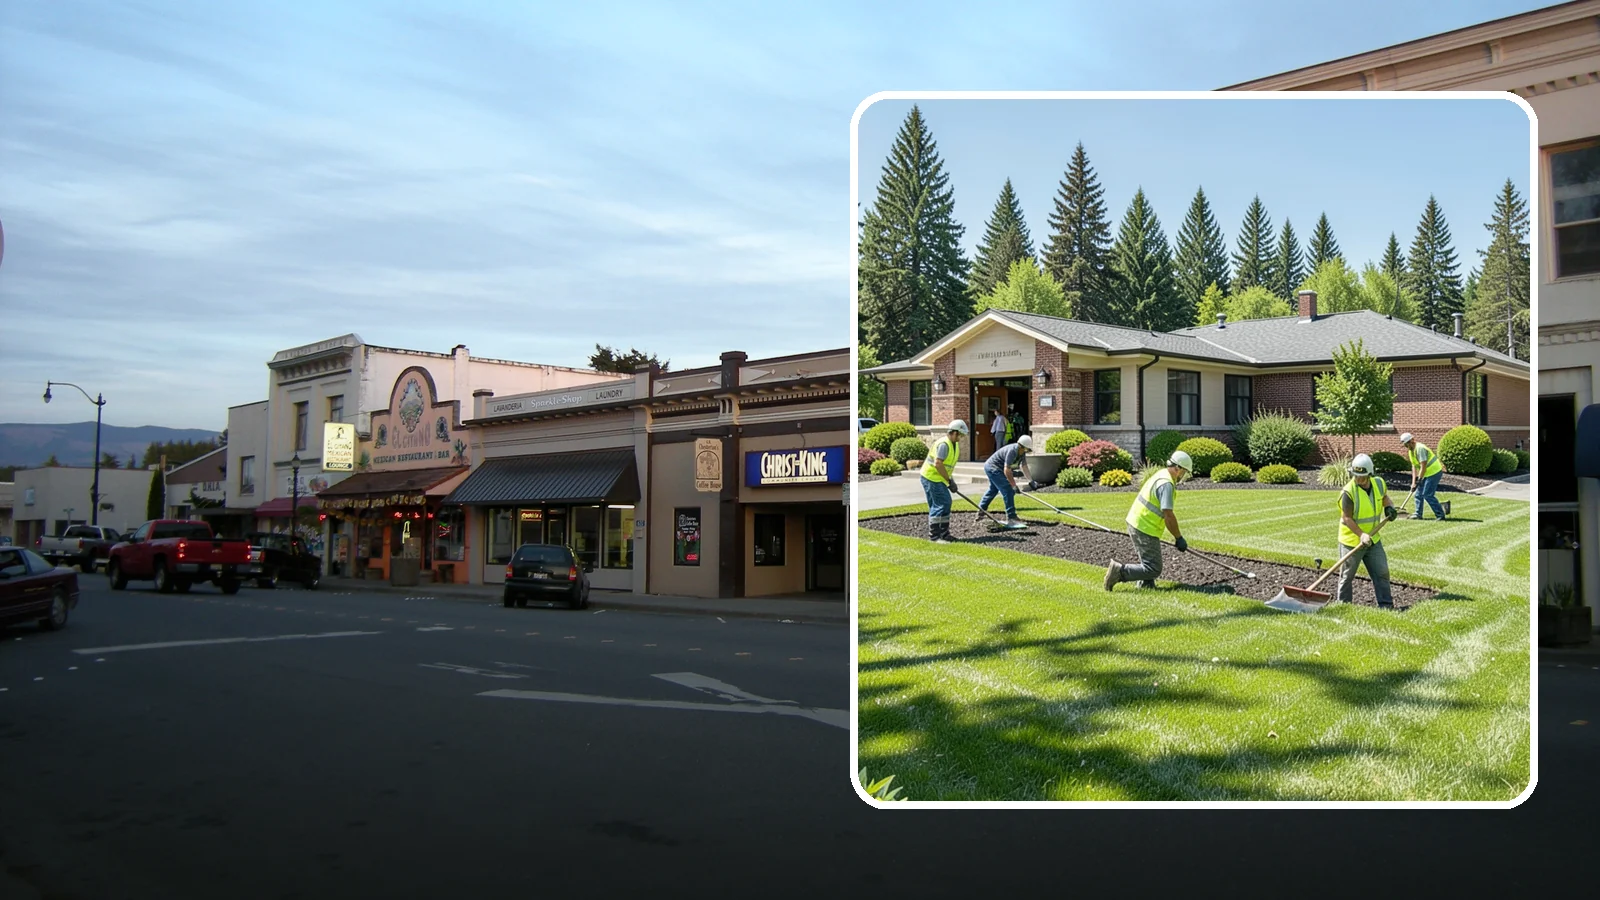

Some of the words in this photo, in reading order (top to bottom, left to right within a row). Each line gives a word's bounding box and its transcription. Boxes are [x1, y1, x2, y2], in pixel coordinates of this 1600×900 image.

[595, 389, 624, 400] LAUNDRY
[493, 402, 523, 413] LAVANDERIA
[373, 454, 396, 464] MEXICAN
[397, 451, 434, 462] RESTAURANT
[437, 450, 450, 459] BAR
[760, 452, 798, 478] CHRIST
[799, 450, 828, 476] KING
